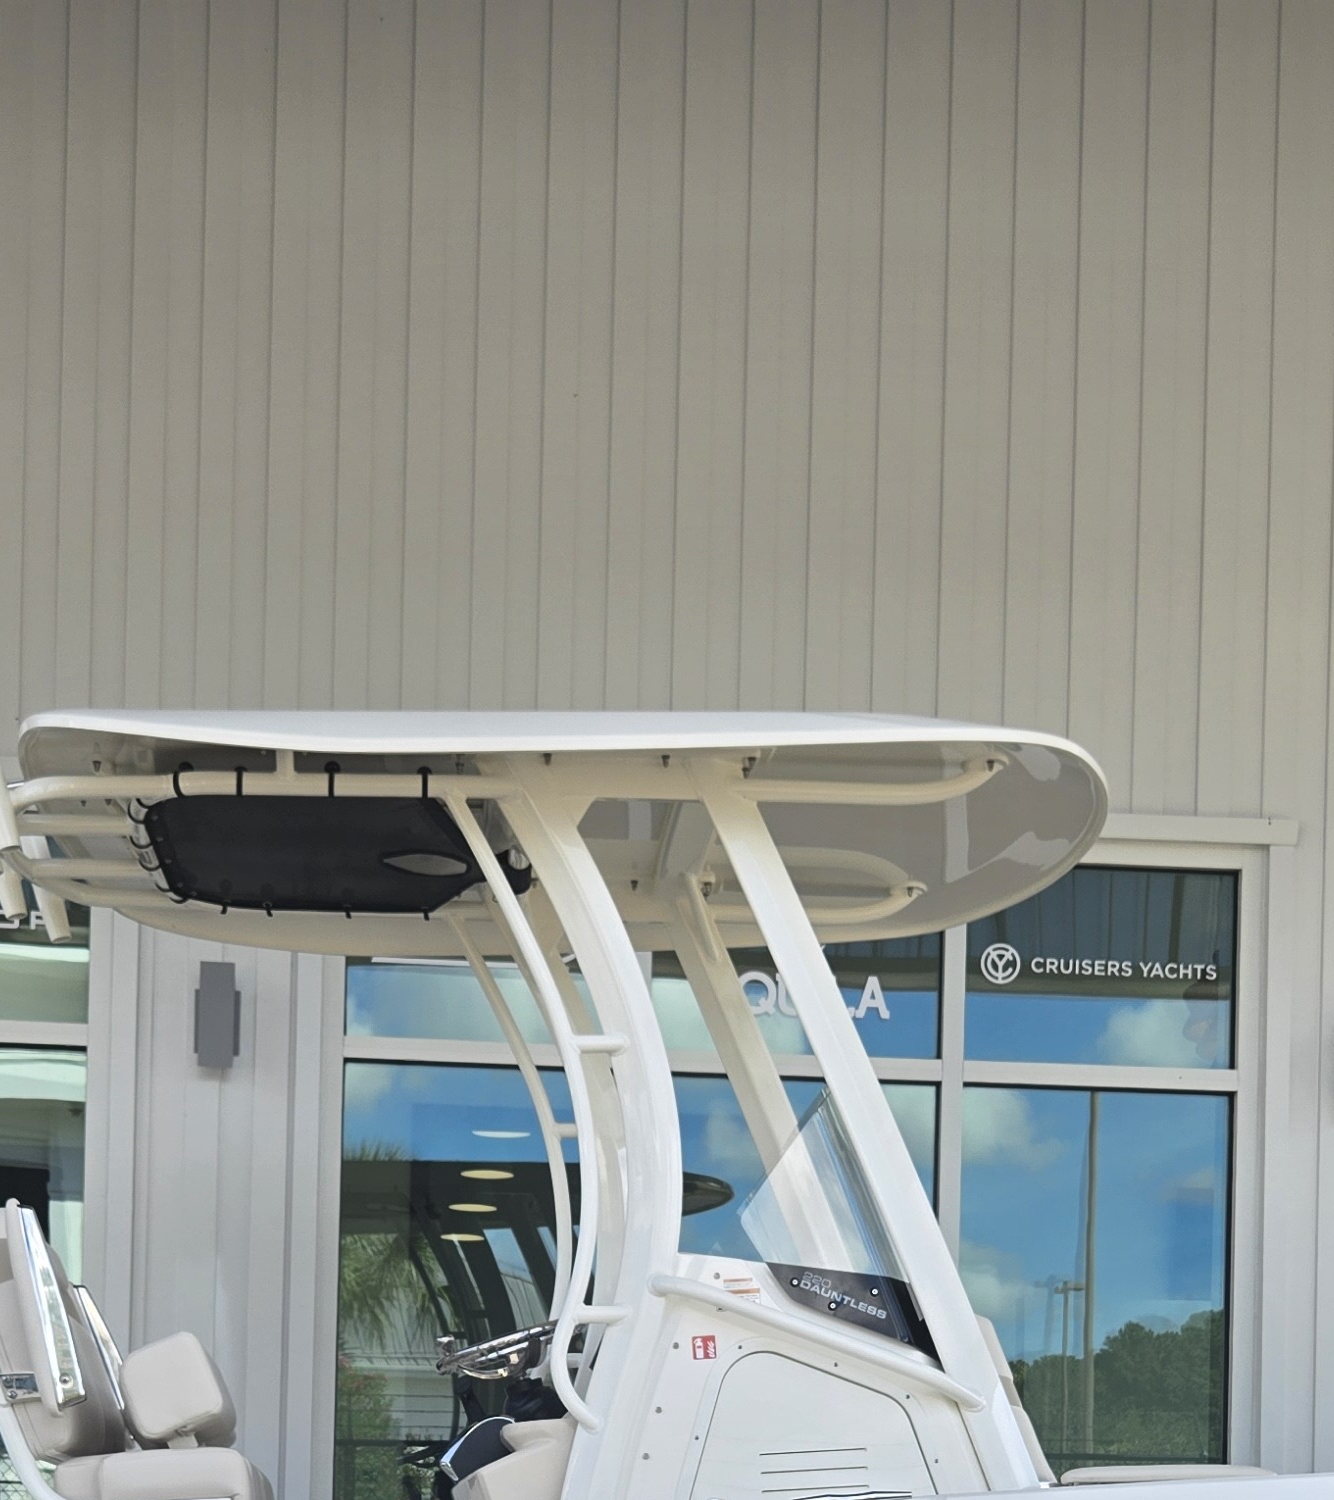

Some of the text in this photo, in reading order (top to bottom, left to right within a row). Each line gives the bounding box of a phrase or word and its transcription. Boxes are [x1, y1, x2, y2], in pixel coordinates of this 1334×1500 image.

[1030, 957, 1218, 981] CRUISERS YACHTS
[802, 1271, 832, 1289] 220
[799, 1280, 887, 1320] DAUNTLESS
